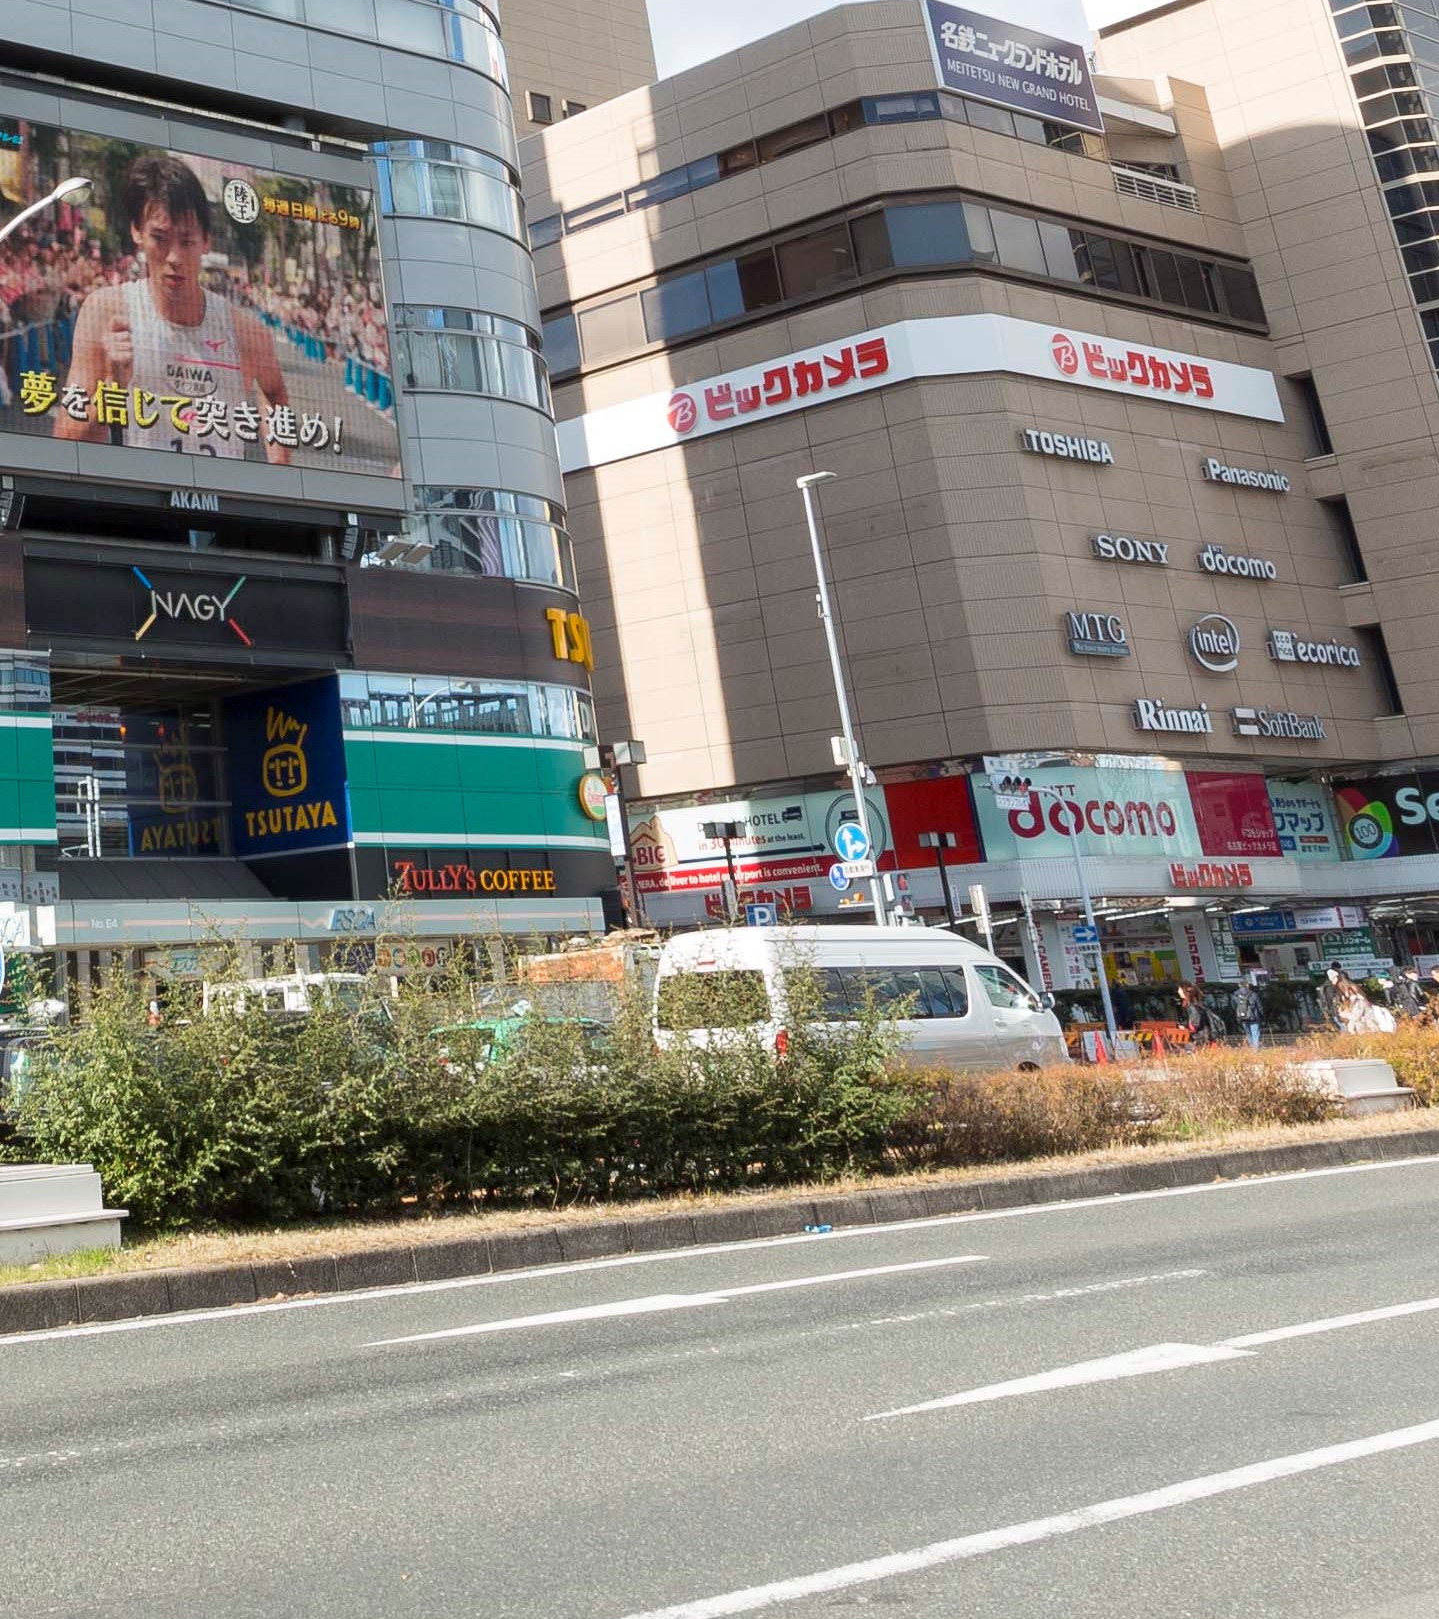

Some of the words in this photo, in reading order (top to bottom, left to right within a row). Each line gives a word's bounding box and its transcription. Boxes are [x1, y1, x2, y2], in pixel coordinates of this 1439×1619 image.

[940, 20, 1083, 86] 名鉄ニューグランドホテル
[946, 58, 996, 85] MEITETSU
[998, 71, 1021, 91] NEW
[1021, 78, 1058, 102] GRAND
[1058, 88, 1092, 112] HOTEL
[166, 364, 214, 383] DAIWA
[705, 337, 892, 420] ビックカメラ
[1081, 340, 1215, 399] ビックカメラ
[1024, 428, 1115, 465] TOSHIBA
[1205, 457, 1290, 493] Panasonic
[169, 489, 220, 513] AKAMI
[1094, 533, 1169, 566] SONY
[1201, 543, 1277, 581] docomo
[1066, 610, 1126, 644] MTG
[1134, 697, 1213, 734] Rinnai
[1257, 705, 1327, 740] SoftBank
[245, 800, 338, 838] TSUTAYA
[744, 813, 781, 828] HOTEL
[1008, 790, 1176, 839] docomo
[1273, 811, 1325, 833] フマップ
[1354, 823, 1378, 840] 100
[636, 844, 666, 866] BIC
[772, 862, 823, 877] convenient.
[479, 868, 556, 892] COFFEE
[1170, 863, 1254, 888] ビックカメラ
